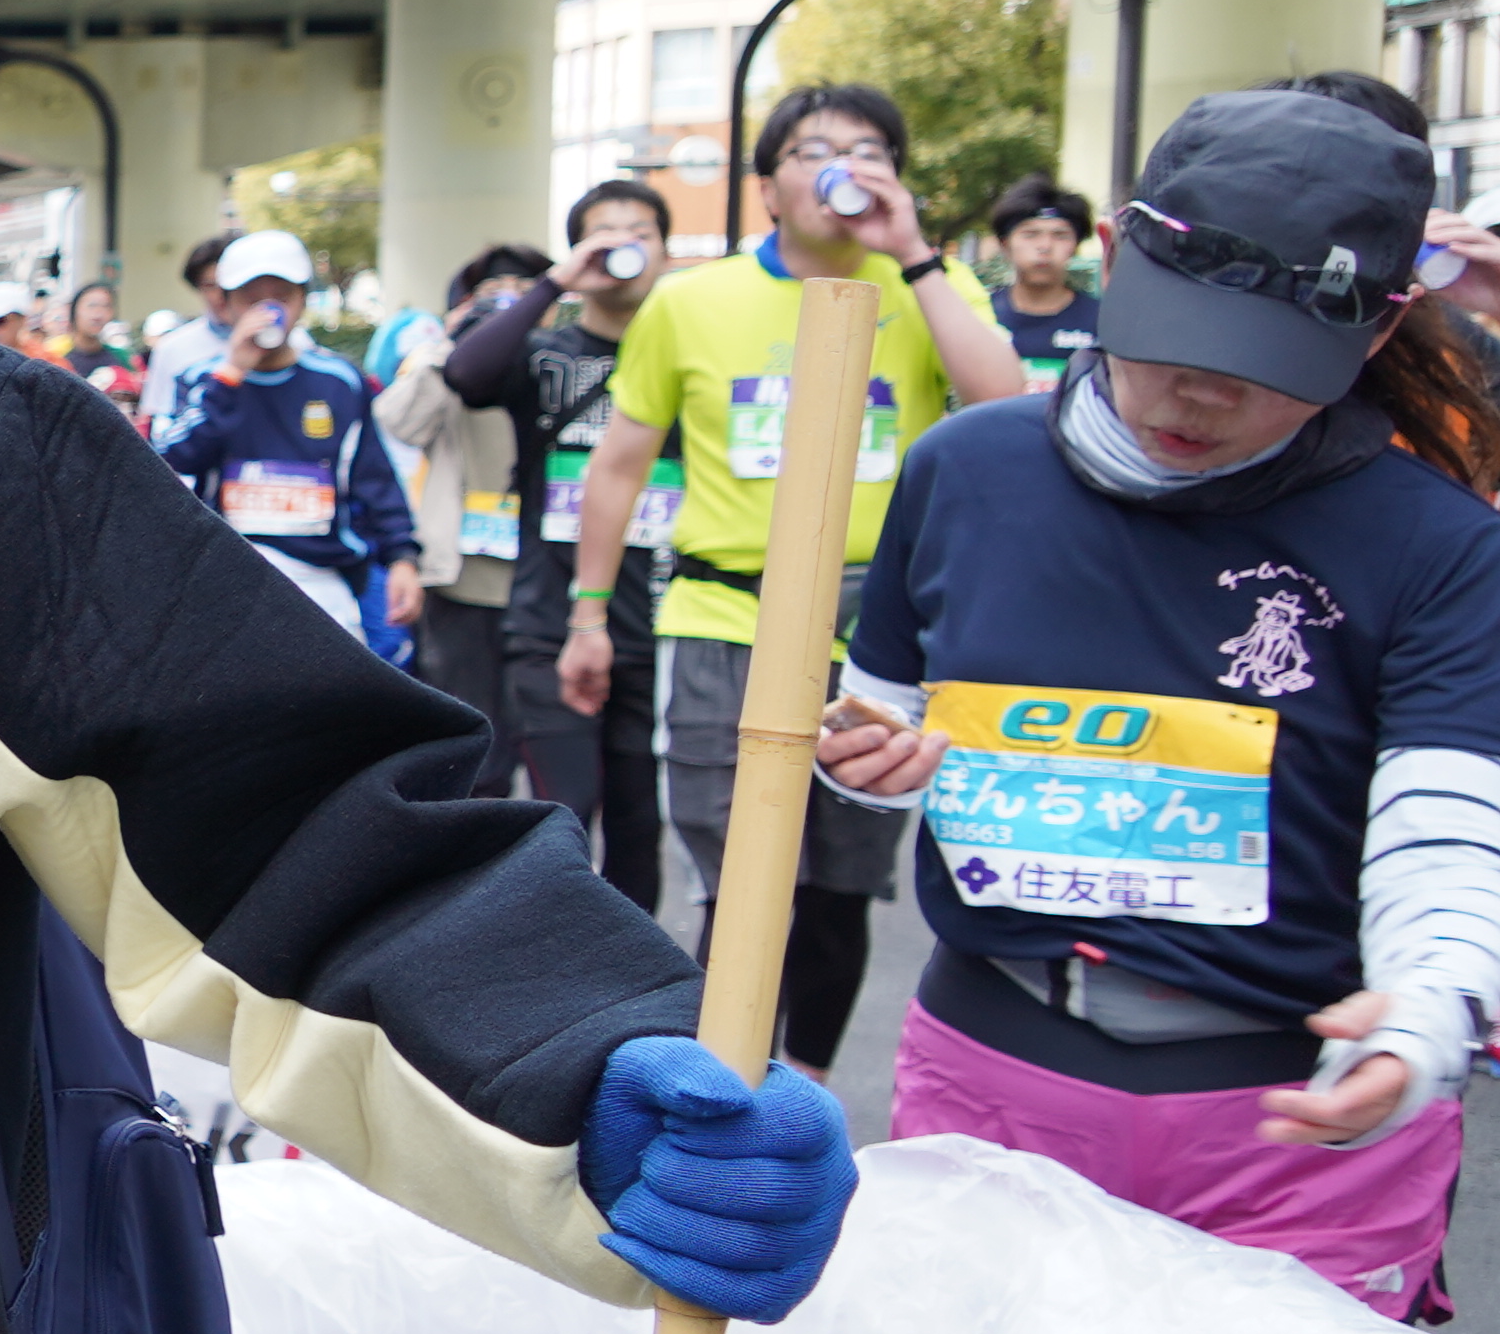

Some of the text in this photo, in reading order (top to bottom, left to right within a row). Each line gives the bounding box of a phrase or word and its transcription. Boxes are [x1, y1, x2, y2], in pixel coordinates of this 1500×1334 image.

[1001, 699, 1151, 747] eo
[1013, 861, 1196, 910] 住友電工
